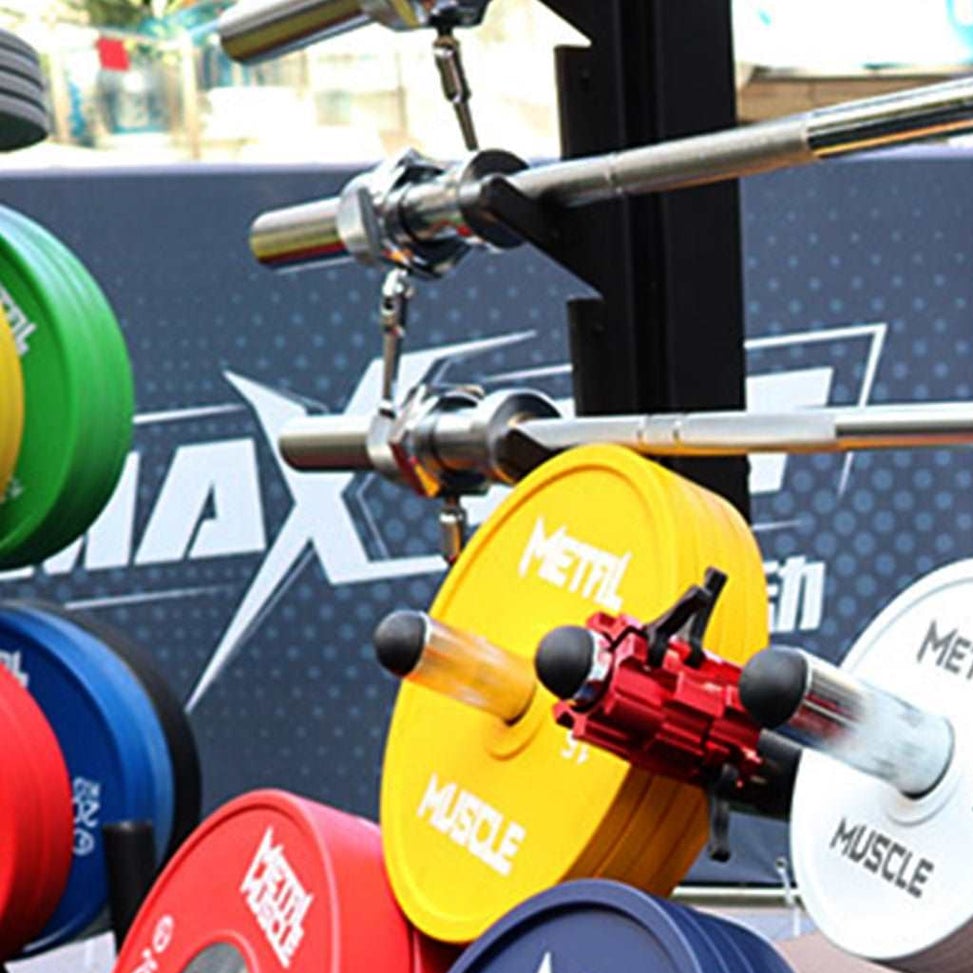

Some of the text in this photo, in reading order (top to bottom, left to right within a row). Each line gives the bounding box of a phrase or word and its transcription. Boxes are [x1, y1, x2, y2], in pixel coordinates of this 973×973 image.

[517, 516, 634, 613] METAL
[417, 774, 526, 876] MUSCLE
[829, 817, 935, 899] MUSCLE
